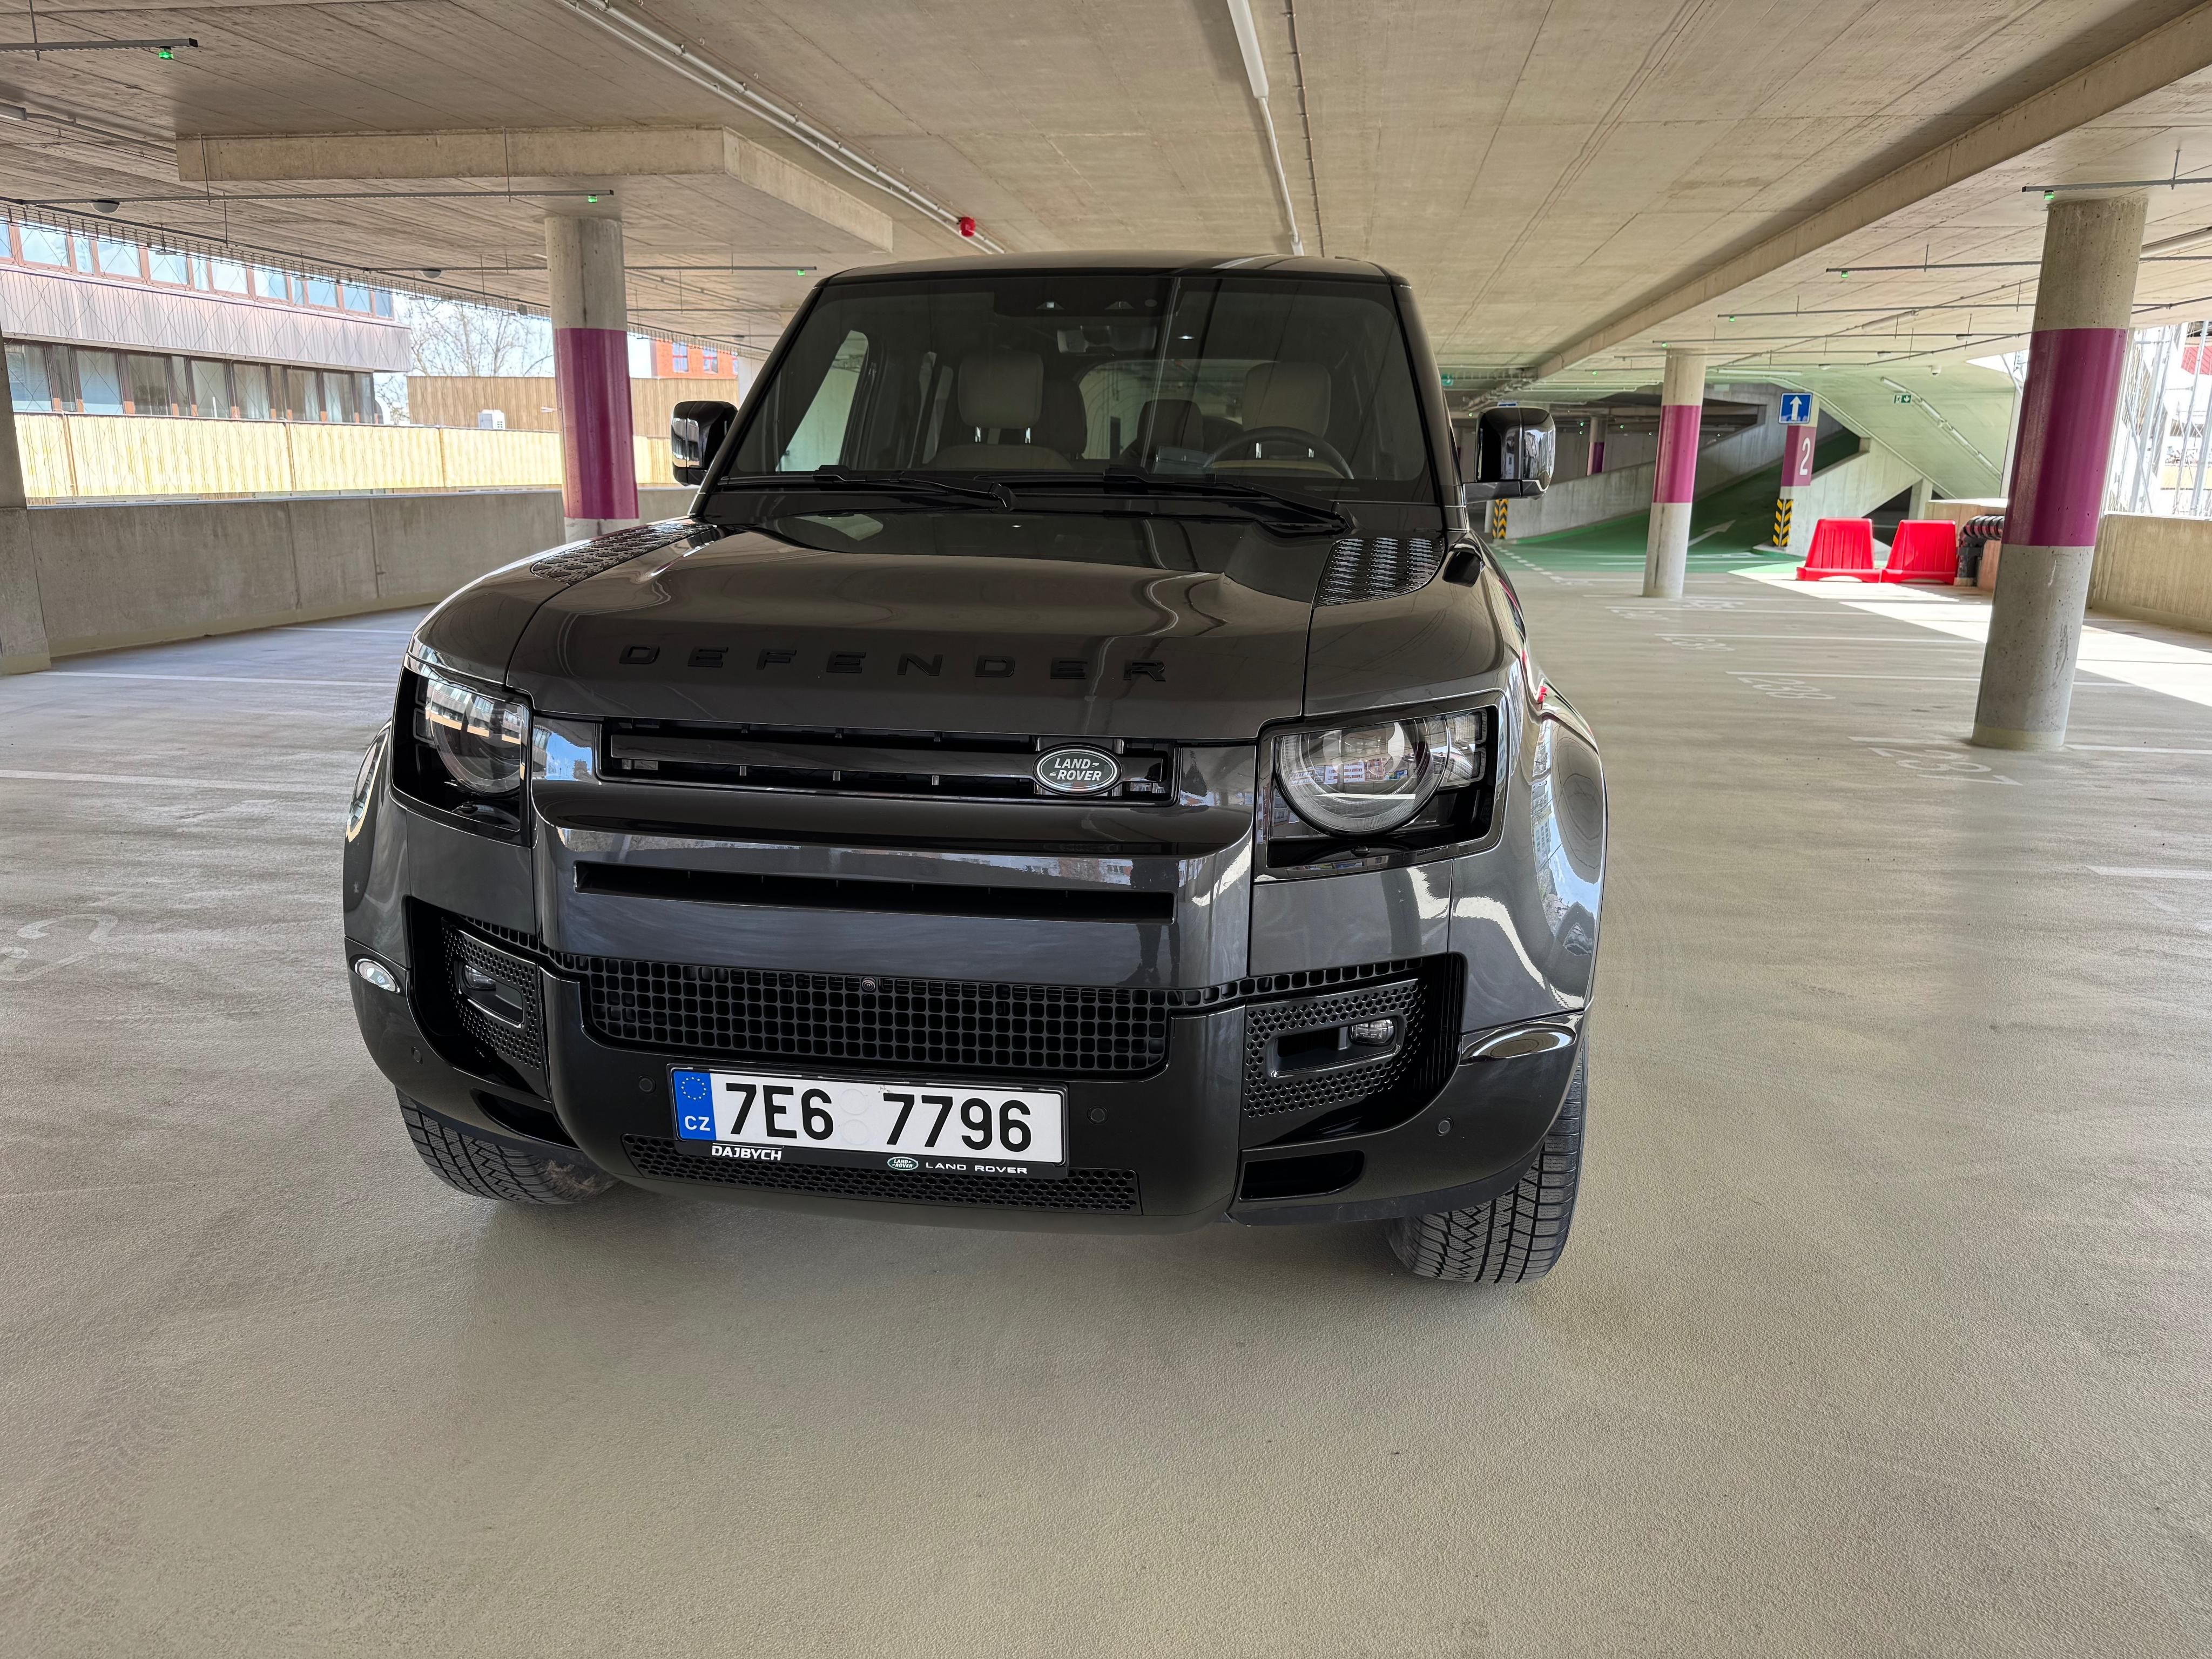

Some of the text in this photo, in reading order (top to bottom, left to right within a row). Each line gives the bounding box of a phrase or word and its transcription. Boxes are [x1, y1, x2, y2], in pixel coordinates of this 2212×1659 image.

[1799, 437, 1811, 476] 2
[619, 644, 1166, 682] DEFENDER
[1738, 677, 1836, 700] 238
[1054, 758, 1091, 769] LAND
[1056, 770, 1102, 781] ROVER
[684, 1115, 711, 1131] CZ
[725, 1082, 1032, 1152] 7E6 7796
[711, 1145, 782, 1161] DAJBYCH
[926, 1162, 1028, 1175] LAND ROVER
